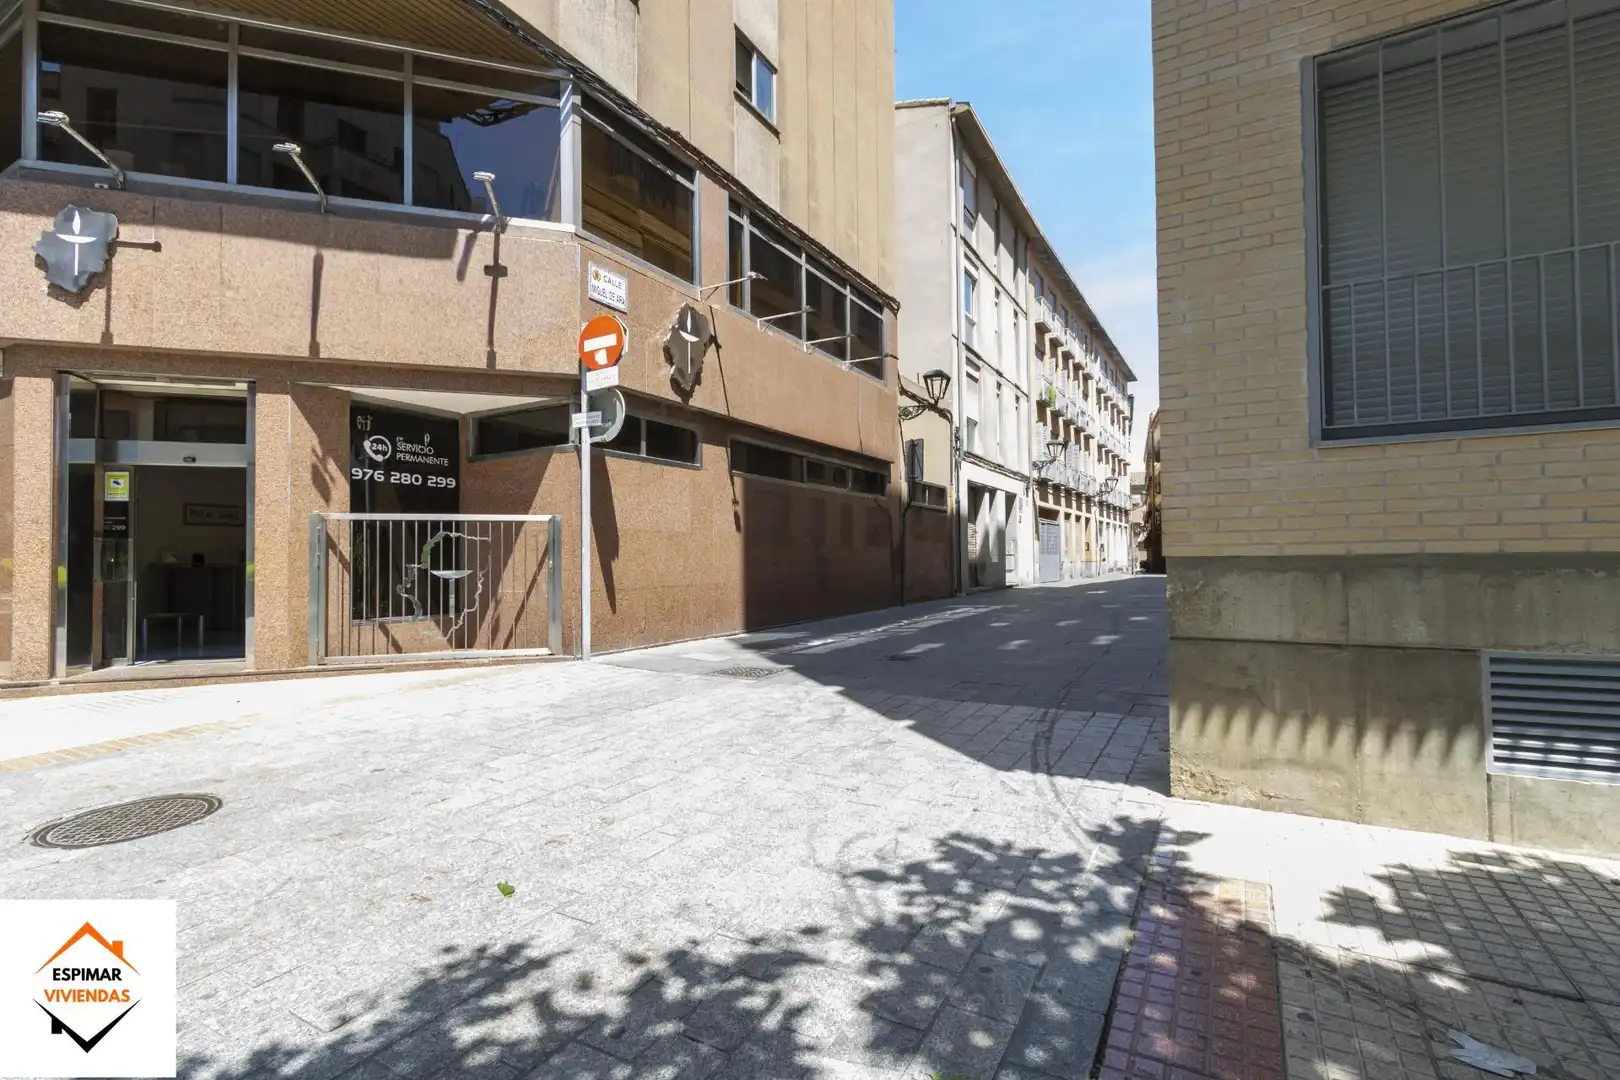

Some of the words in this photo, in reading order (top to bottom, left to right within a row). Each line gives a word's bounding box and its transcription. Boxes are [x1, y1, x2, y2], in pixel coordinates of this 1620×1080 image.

[603, 275, 622, 290] CALLE
[371, 443, 388, 451] 24h
[396, 443, 434, 454] SERVICIO
[396, 453, 449, 466] PERMANENTE
[351, 468, 385, 482] 976
[390, 471, 422, 485] 280
[427, 475, 456, 488] 299
